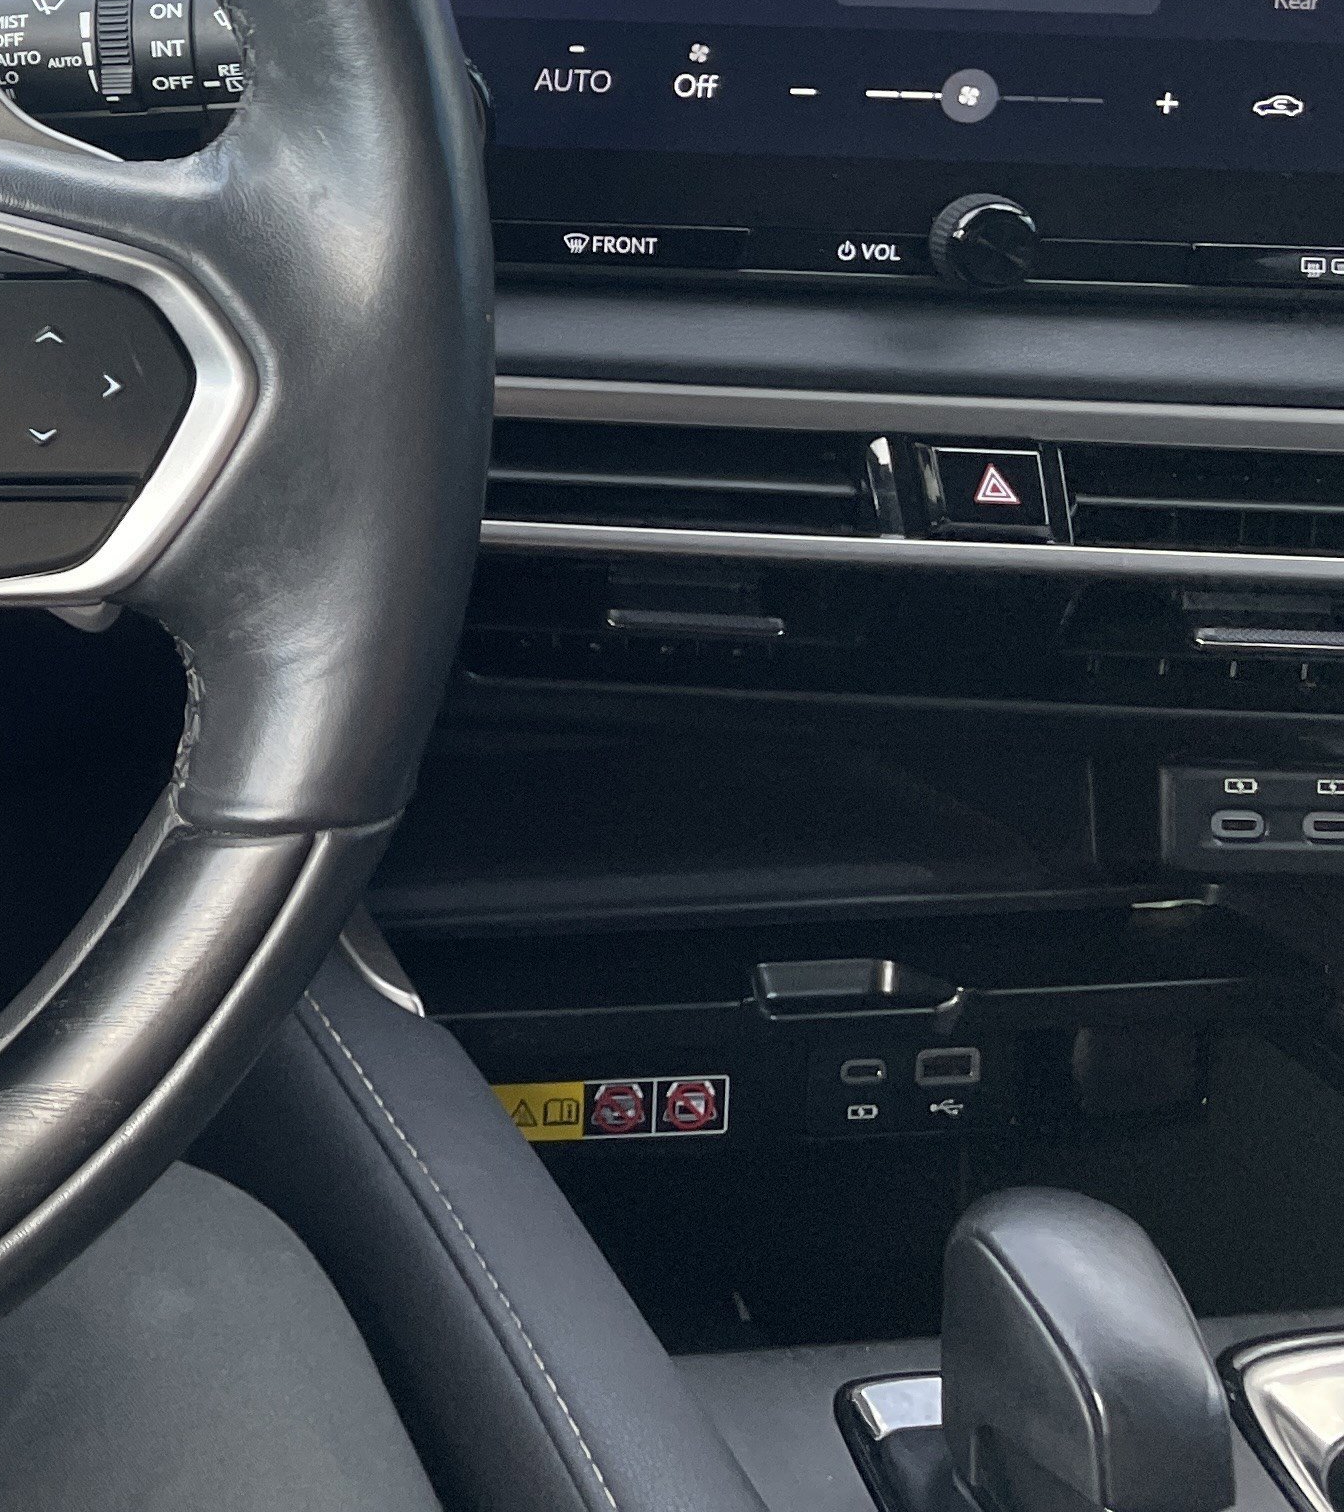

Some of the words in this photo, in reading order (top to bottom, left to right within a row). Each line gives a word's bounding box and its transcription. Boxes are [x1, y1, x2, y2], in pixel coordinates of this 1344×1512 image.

[149, 2, 183, 20] ON
[150, 39, 186, 58] INT
[47, 56, 83, 68] AUTO
[217, 63, 244, 77] RE
[152, 75, 194, 90] OFF
[534, 69, 613, 94] AUTO
[673, 72, 720, 99] Off
[591, 235, 658, 256] FRONT
[860, 242, 901, 262] VOL
